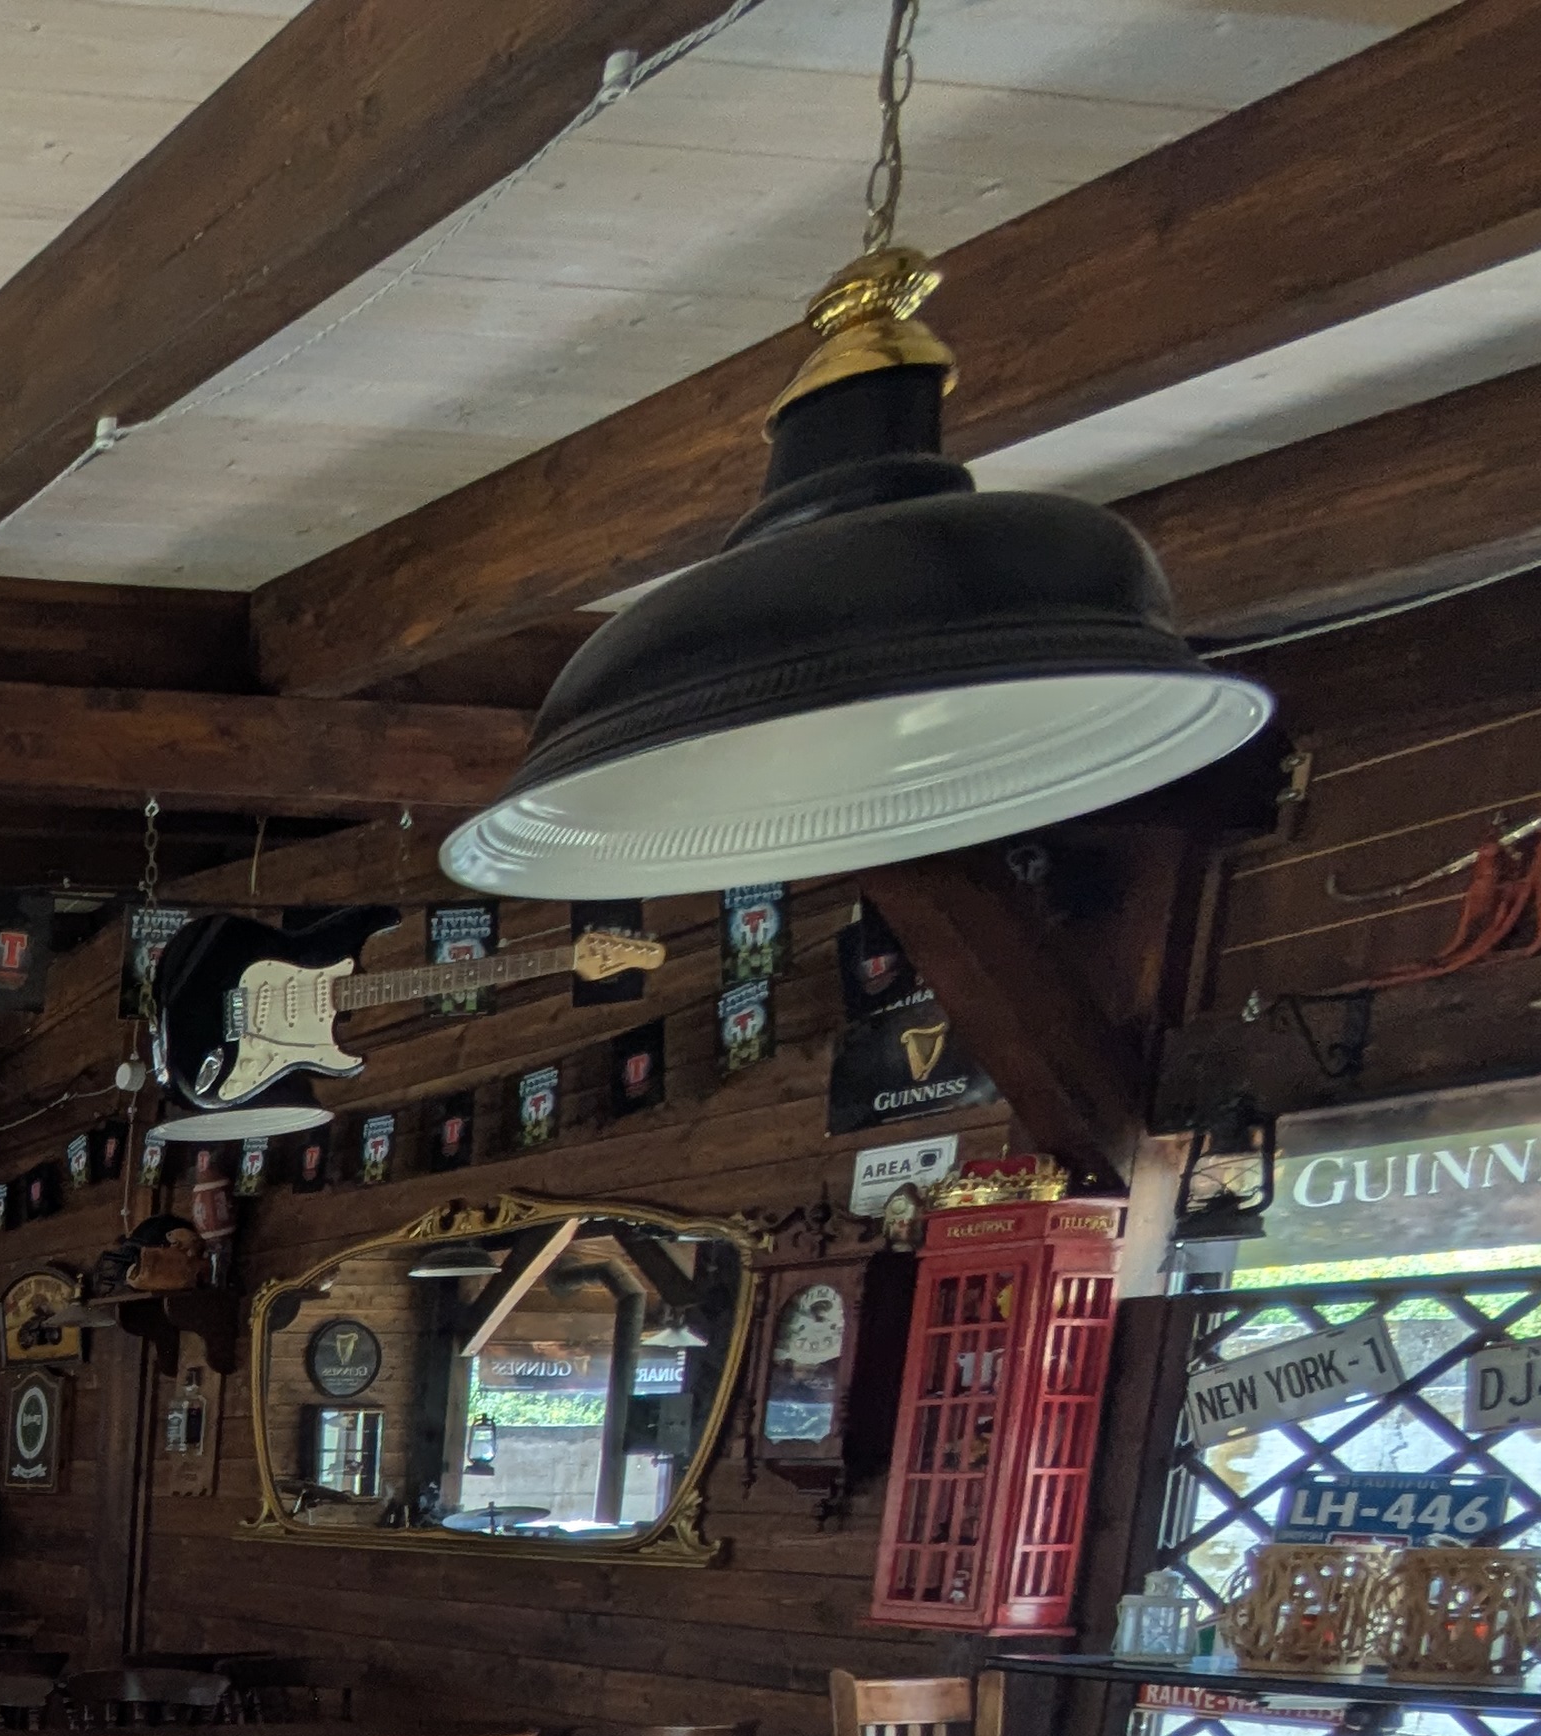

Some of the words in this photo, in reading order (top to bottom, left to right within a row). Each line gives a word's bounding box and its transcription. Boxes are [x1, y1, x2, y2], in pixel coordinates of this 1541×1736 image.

[873, 1077, 968, 1111] GUINNESS
[862, 1158, 912, 1180] AREA
[1293, 1139, 1541, 1207] GUINN
[1194, 1375, 1257, 1425] NEW
[1479, 1362, 1541, 1411] DJ
[1290, 1489, 1490, 1534] LH-446
